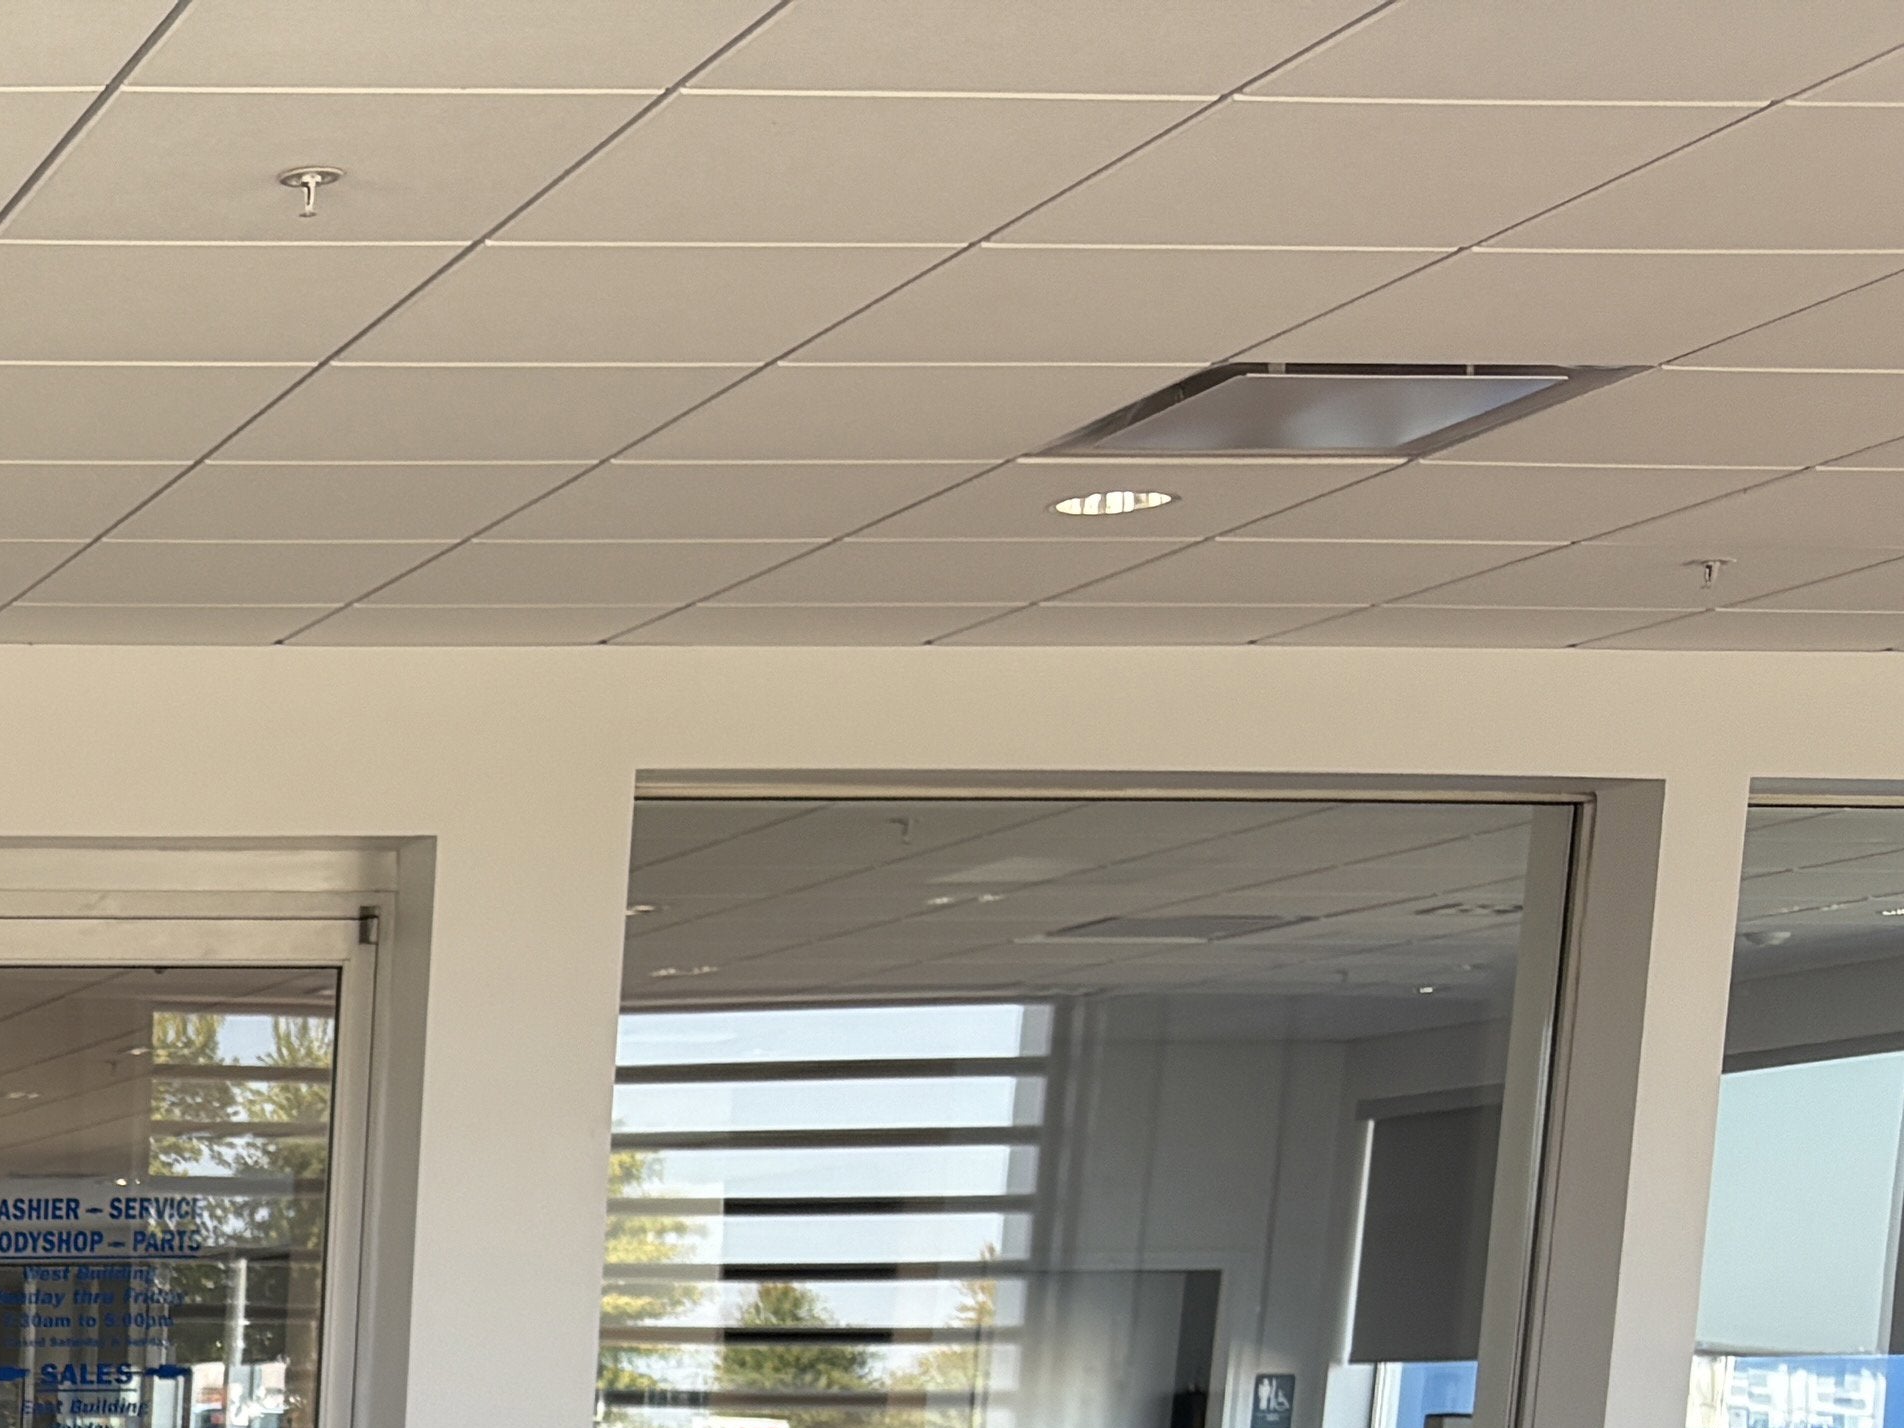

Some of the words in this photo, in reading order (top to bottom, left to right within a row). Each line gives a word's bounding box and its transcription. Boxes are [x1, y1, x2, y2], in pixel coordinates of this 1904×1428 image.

[132, 1229, 202, 1252] PARTS
[78, 1313, 97, 1328] to
[41, 1363, 134, 1385] SALES
[69, 1399, 149, 1418] Building
